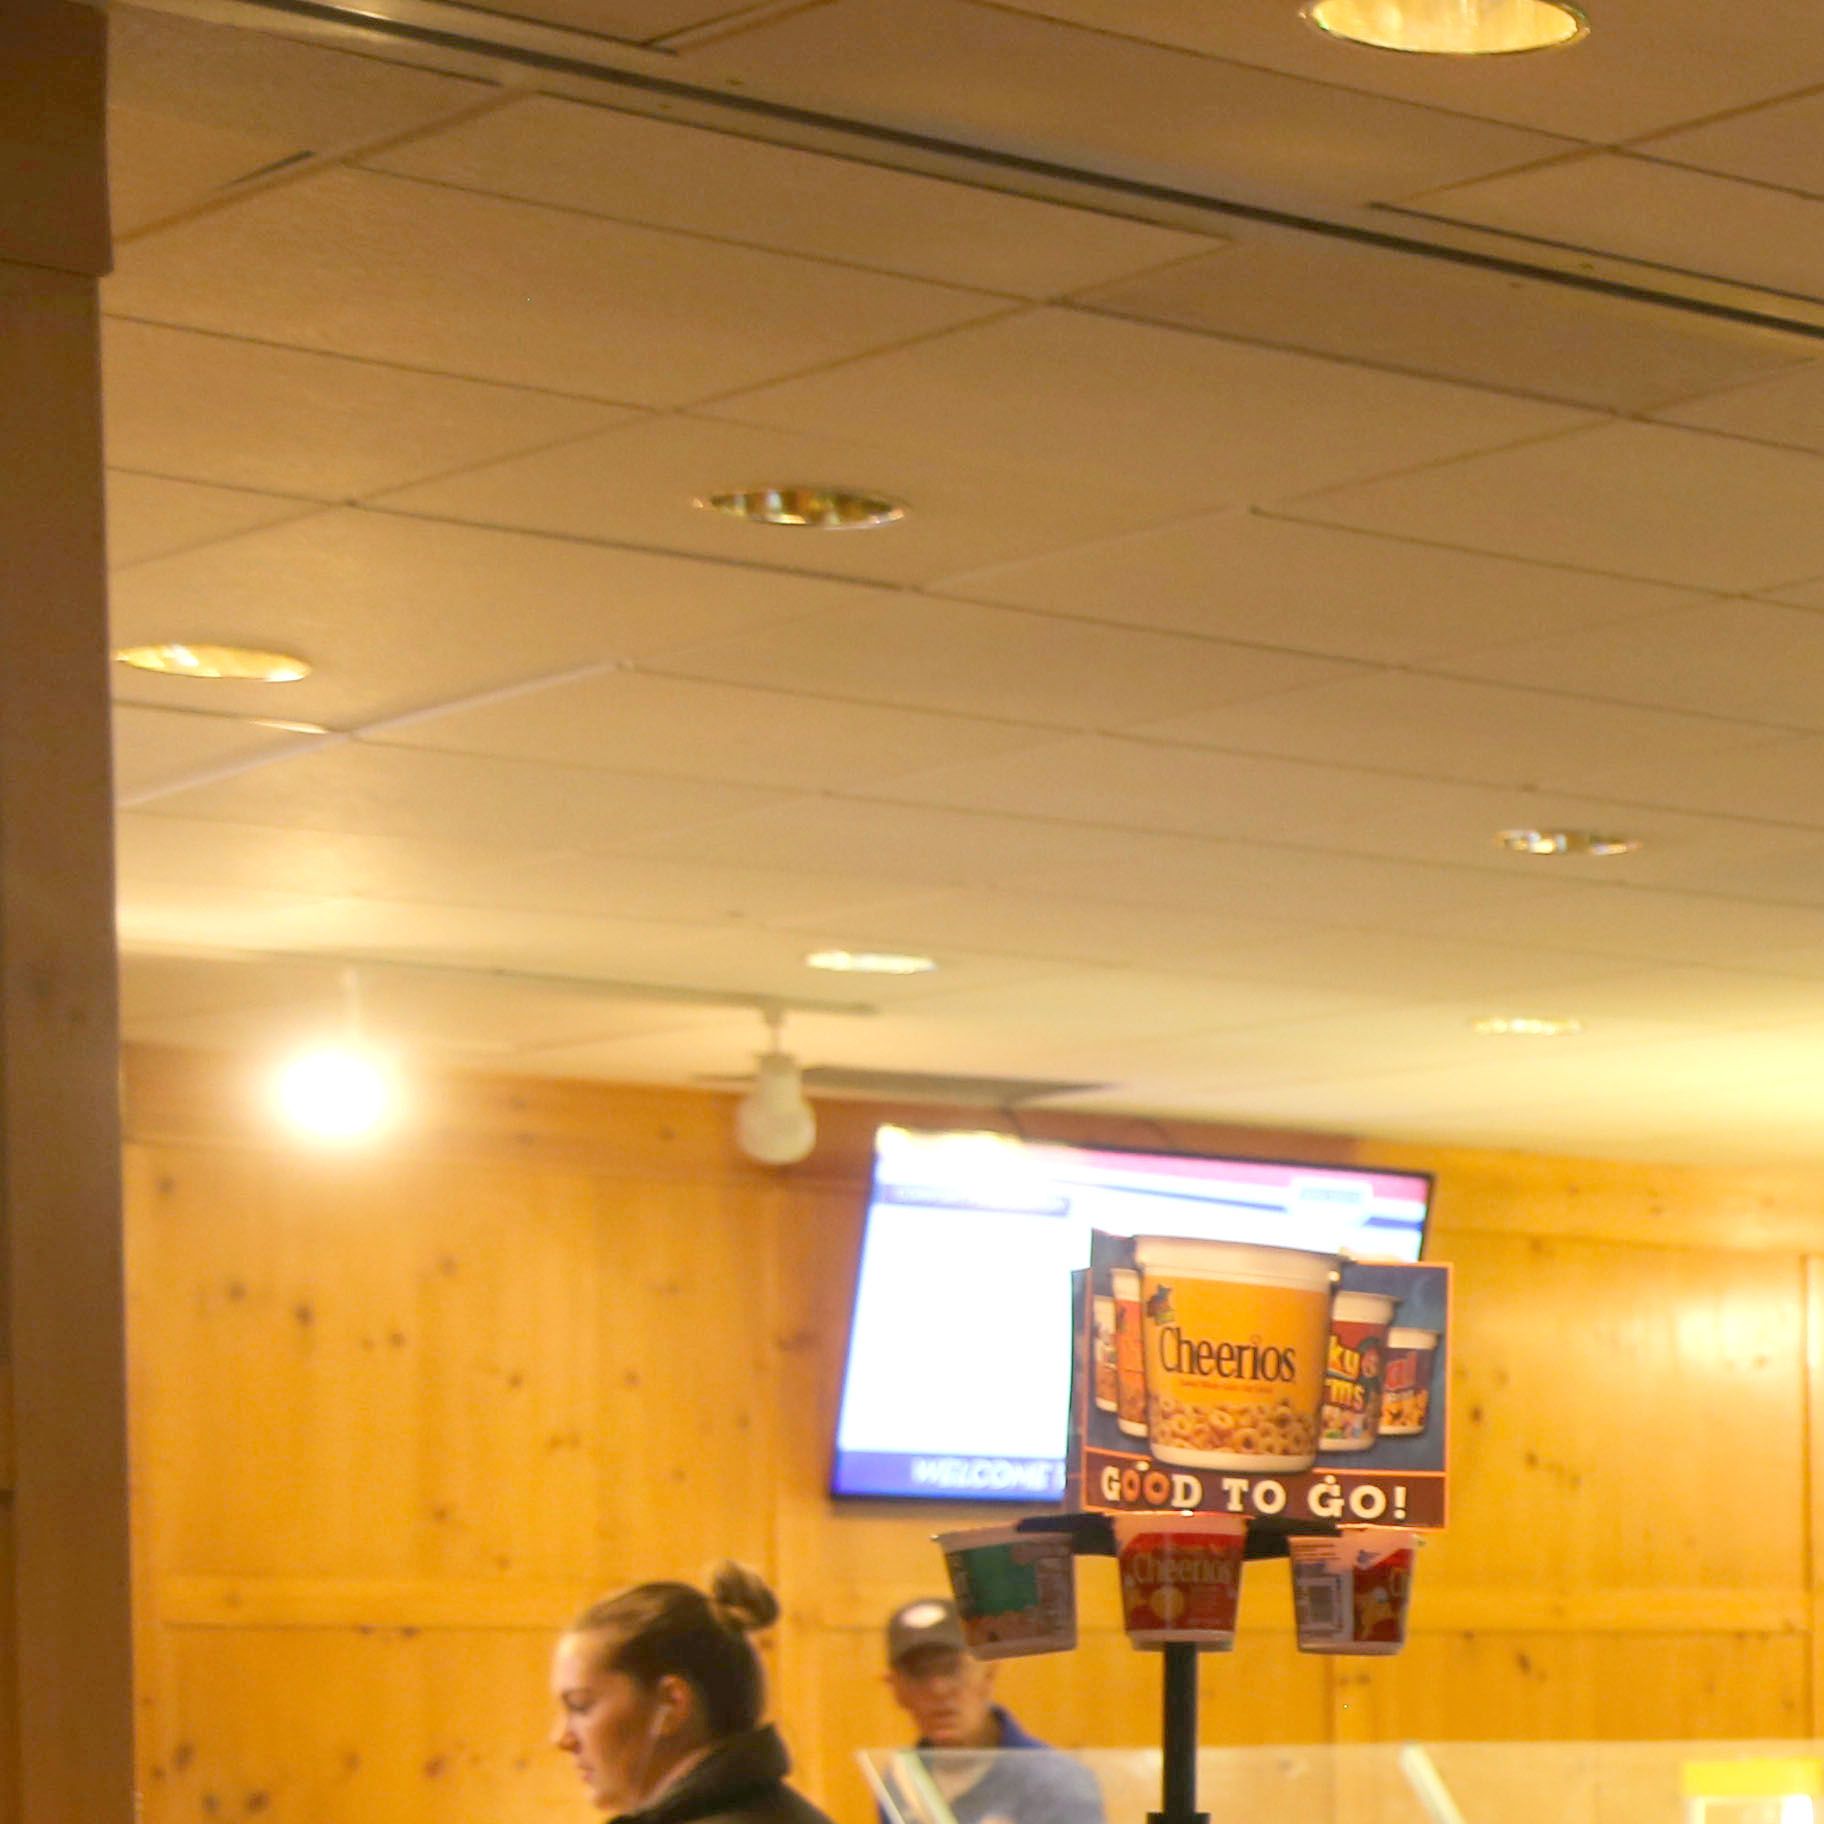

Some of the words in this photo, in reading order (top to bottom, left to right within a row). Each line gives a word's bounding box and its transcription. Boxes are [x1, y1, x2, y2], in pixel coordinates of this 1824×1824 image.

[1158, 1326, 1297, 1383] Cheerios
[912, 1456, 1052, 1491] WELCOME
[1101, 1463, 1203, 1508] GOOD
[1222, 1478, 1287, 1514] TO
[1308, 1477, 1408, 1520] GO!
